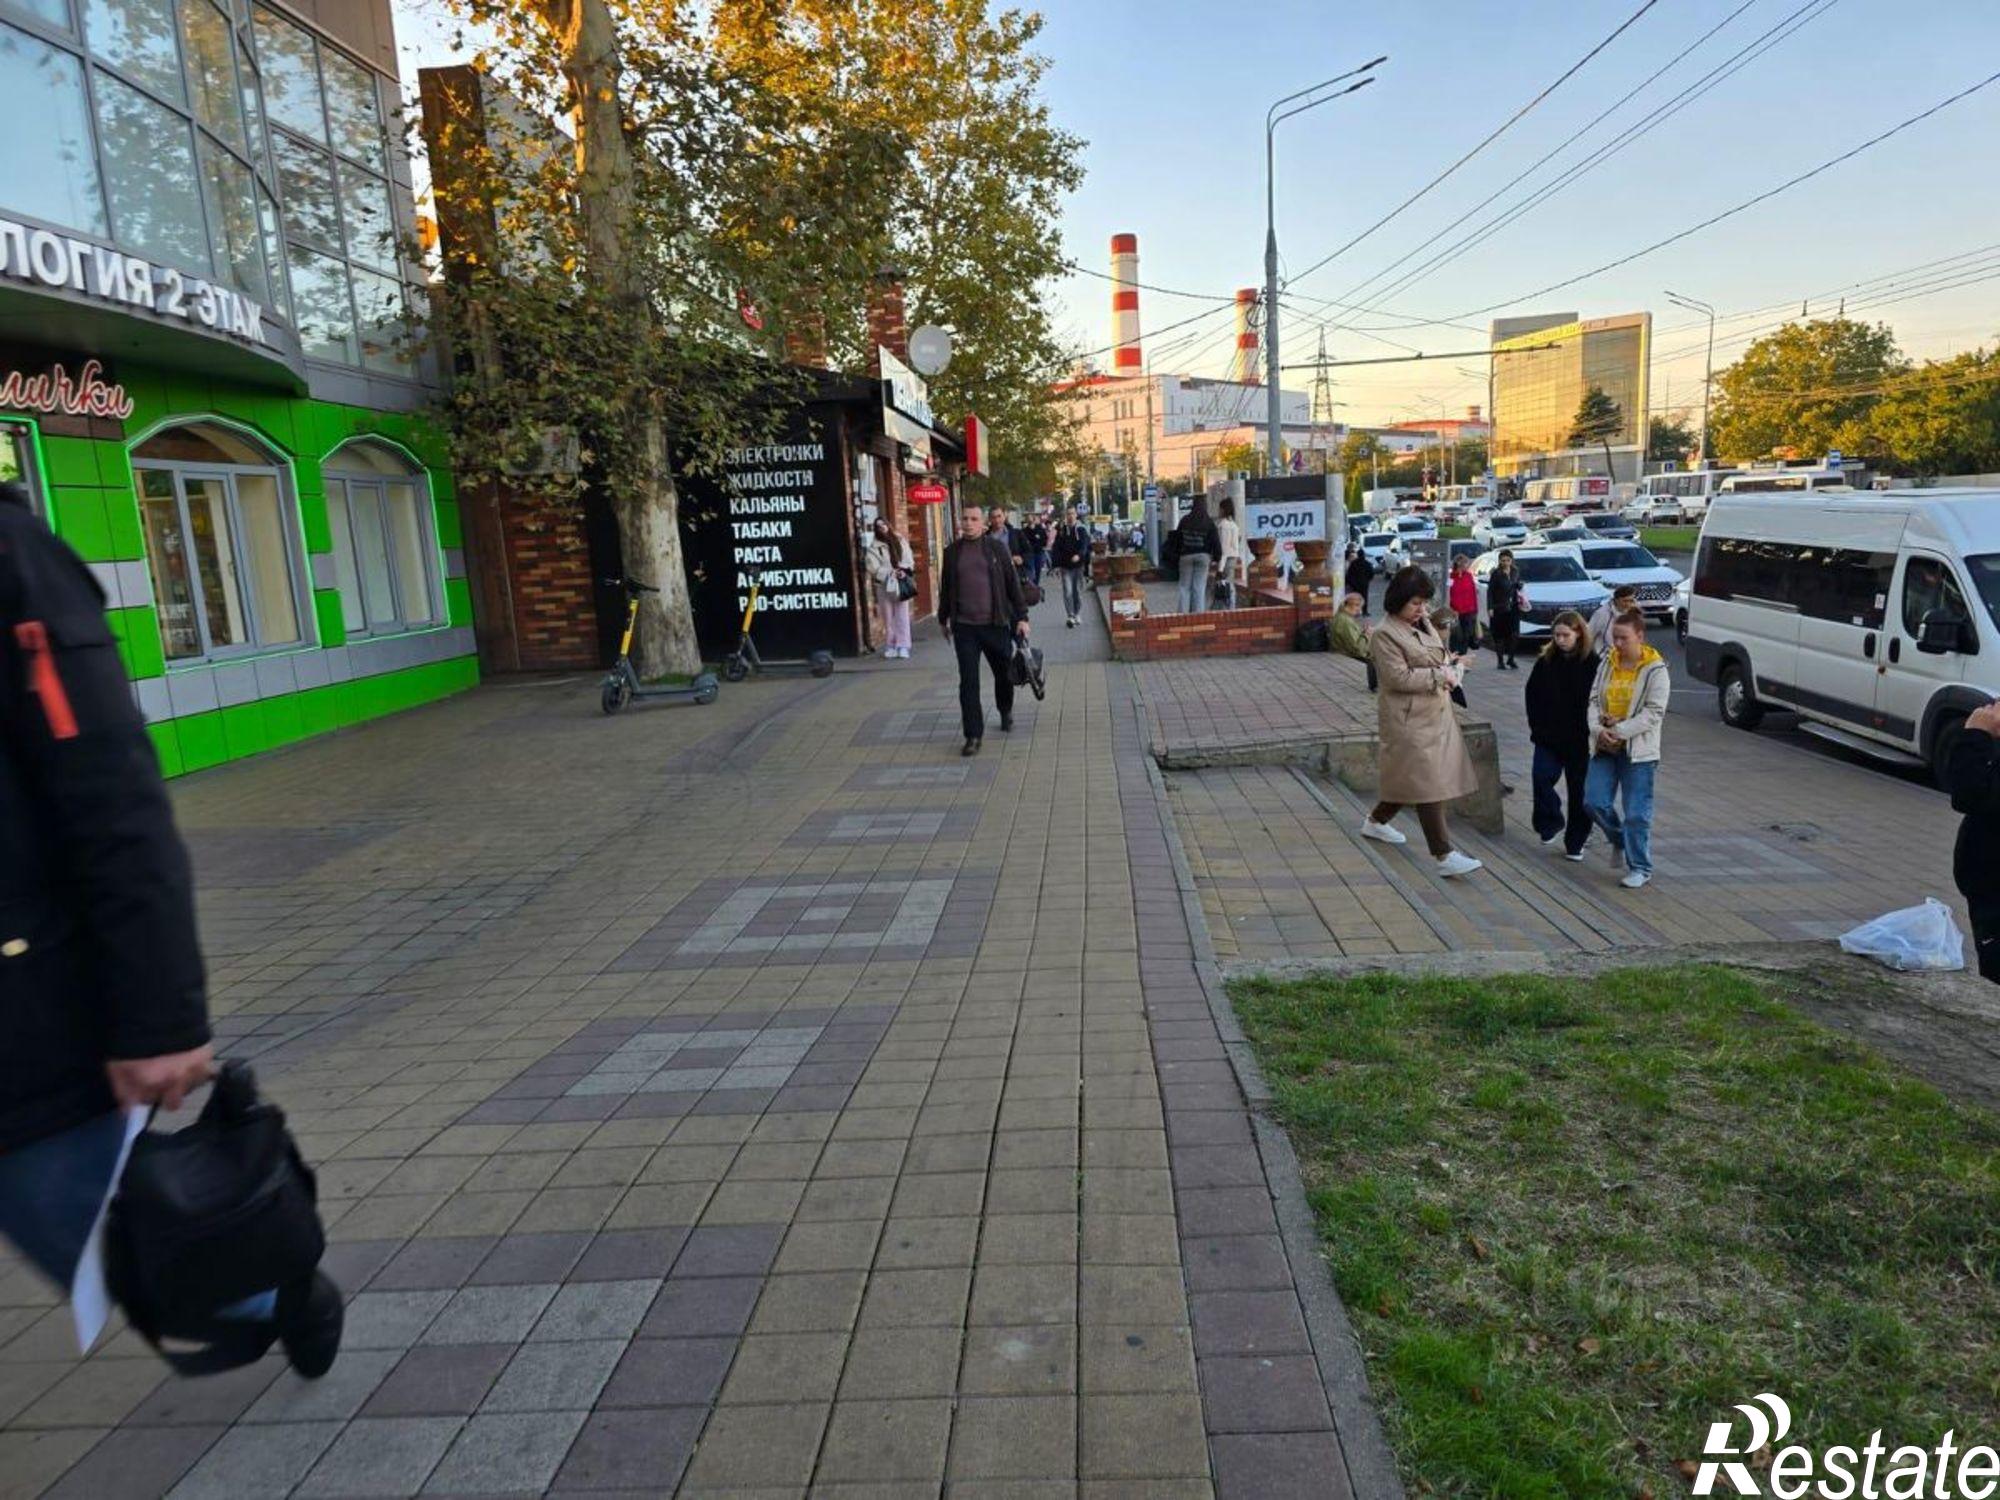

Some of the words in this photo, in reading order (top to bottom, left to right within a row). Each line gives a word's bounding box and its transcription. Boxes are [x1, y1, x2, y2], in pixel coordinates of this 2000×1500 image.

[159, 268, 187, 317] 2
[196, 280, 266, 343] ЭТАЖ
[727, 470, 815, 490] ЖИДКОСТИ
[730, 495, 805, 515] КАЛЬЯНЫ
[731, 520, 792, 539] ТАБАКИ
[1257, 511, 1314, 529] РОЛЛ
[734, 546, 783, 564] РАСТА
